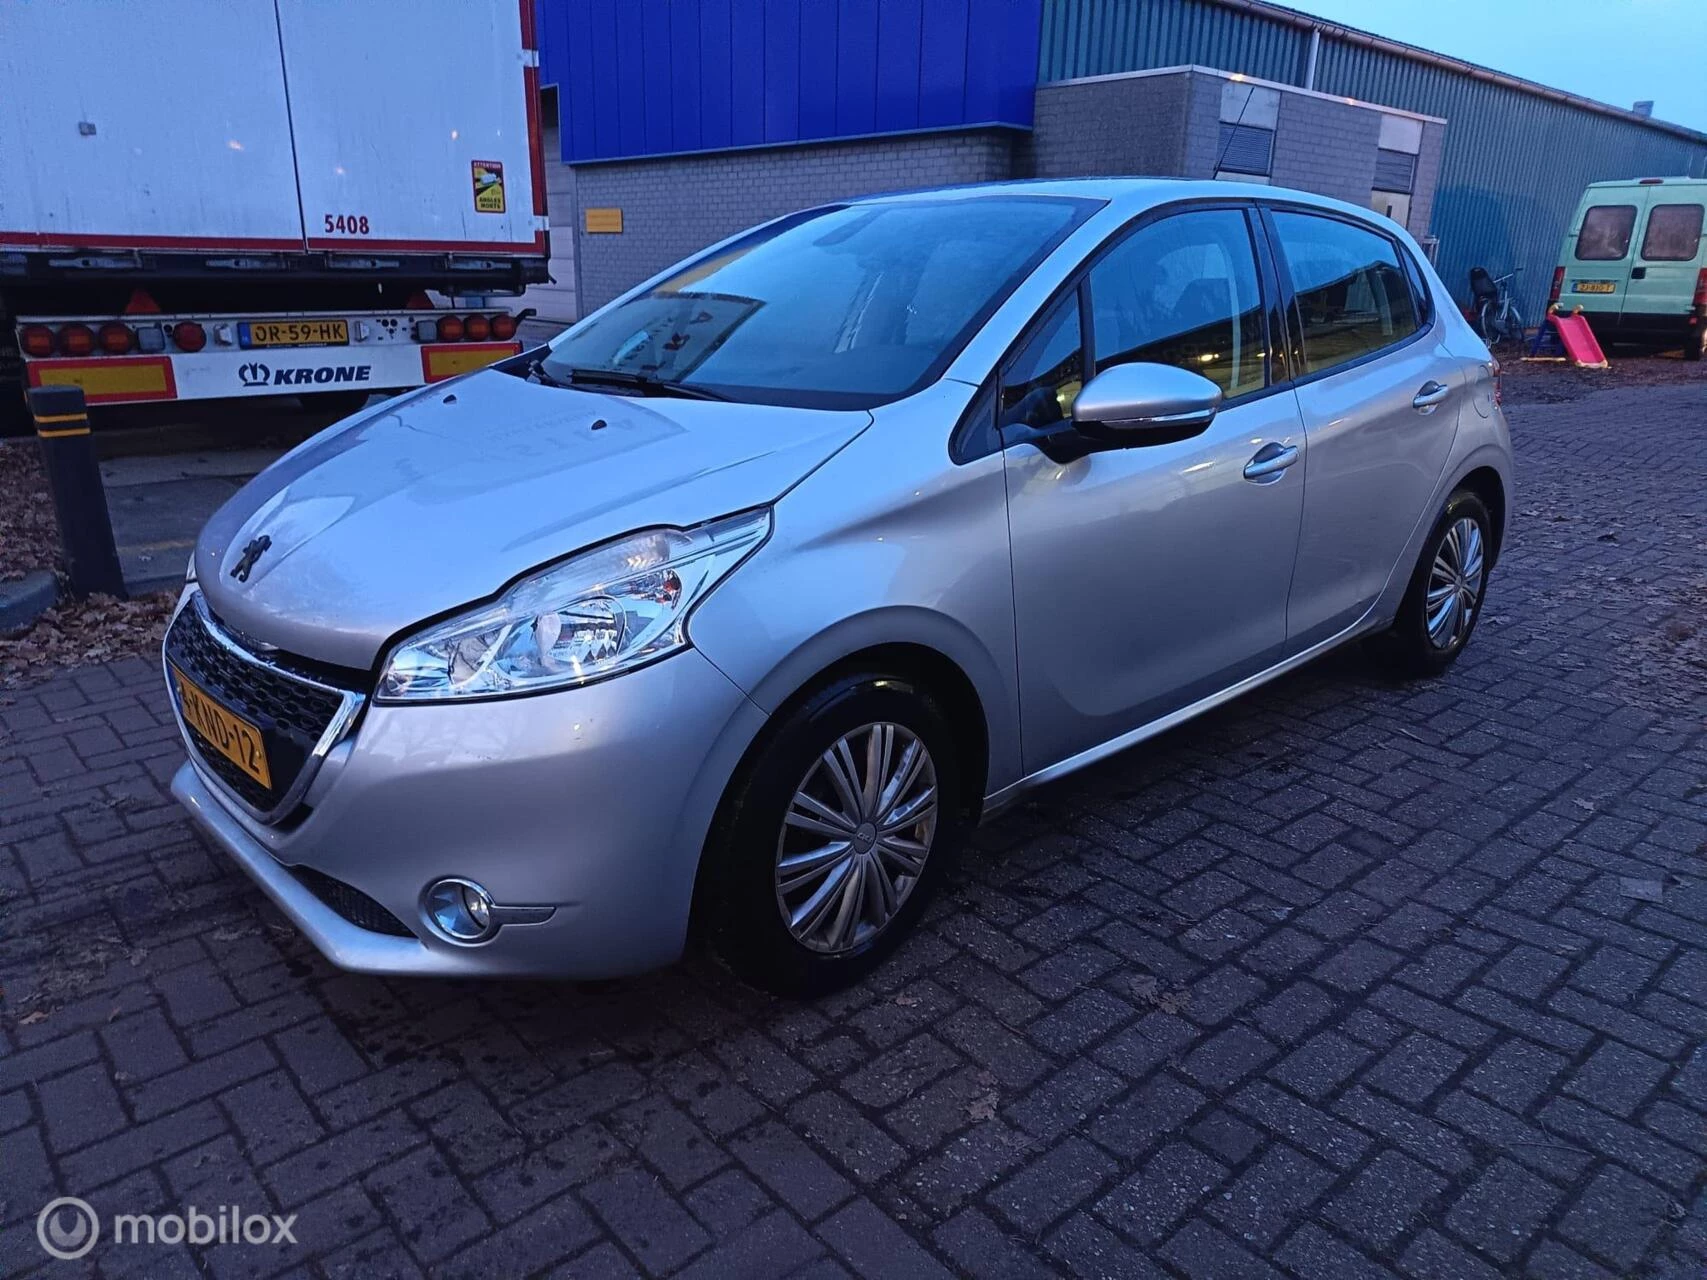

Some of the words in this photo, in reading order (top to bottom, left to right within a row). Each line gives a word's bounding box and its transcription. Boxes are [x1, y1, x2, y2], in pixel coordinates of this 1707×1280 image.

[324, 214, 370, 235] 5408
[255, 323, 344, 342] OR-59-HK
[273, 365, 371, 385] KRONE
